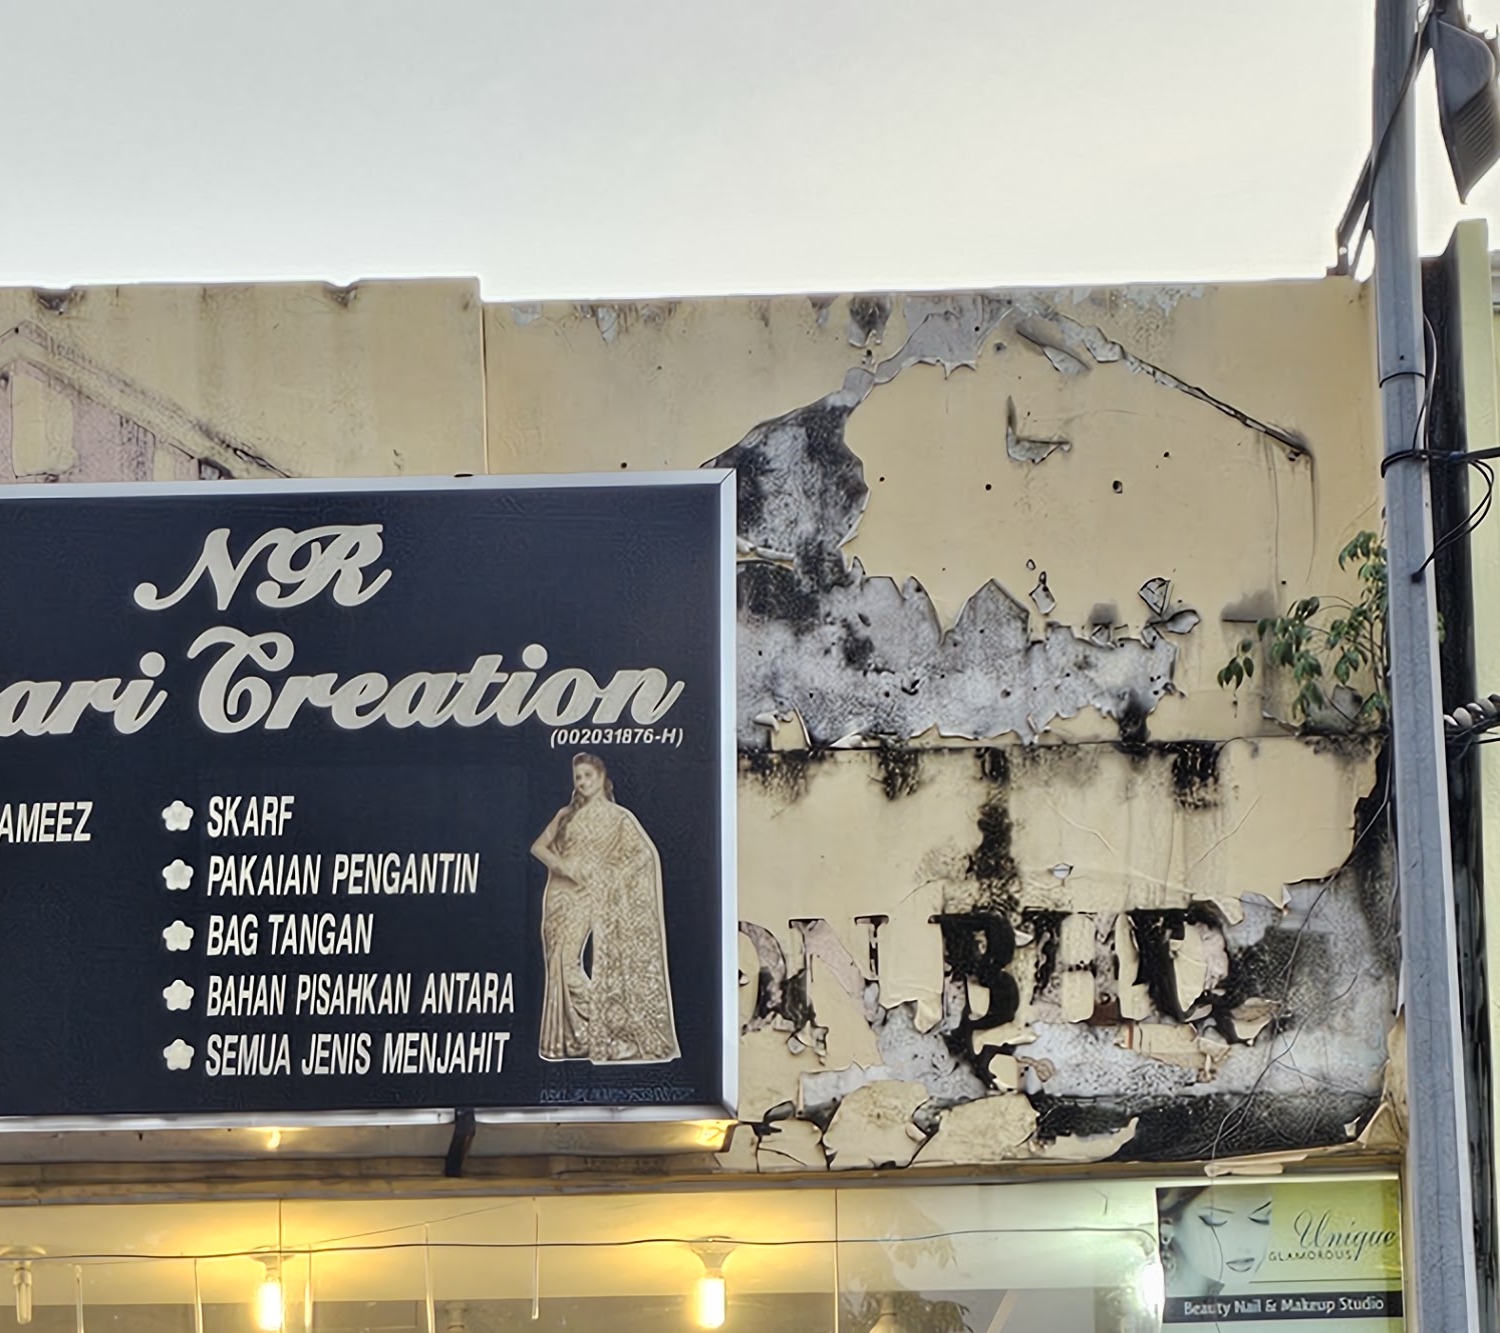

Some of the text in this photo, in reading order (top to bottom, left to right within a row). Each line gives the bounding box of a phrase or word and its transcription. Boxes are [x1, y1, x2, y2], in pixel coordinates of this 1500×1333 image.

[134, 523, 392, 611] NR
[187, 625, 685, 733] Creation
[550, 728, 683, 748] (002031876-H)
[207, 795, 294, 837] SKARF
[206, 853, 479, 896] PAKAIAN PENGANTIN
[206, 913, 373, 956] BAG TANGAN
[206, 972, 514, 1017] BAHAN PISAHKAN ANTARA
[206, 1032, 510, 1076] SEMUA JENIS MENJAHIT
[1268, 1251, 1352, 1262] GLAMOROUS
[1293, 1210, 1396, 1262] Unique
[1184, 1296, 1384, 1317] Beauty Nail & Makeup Studio
